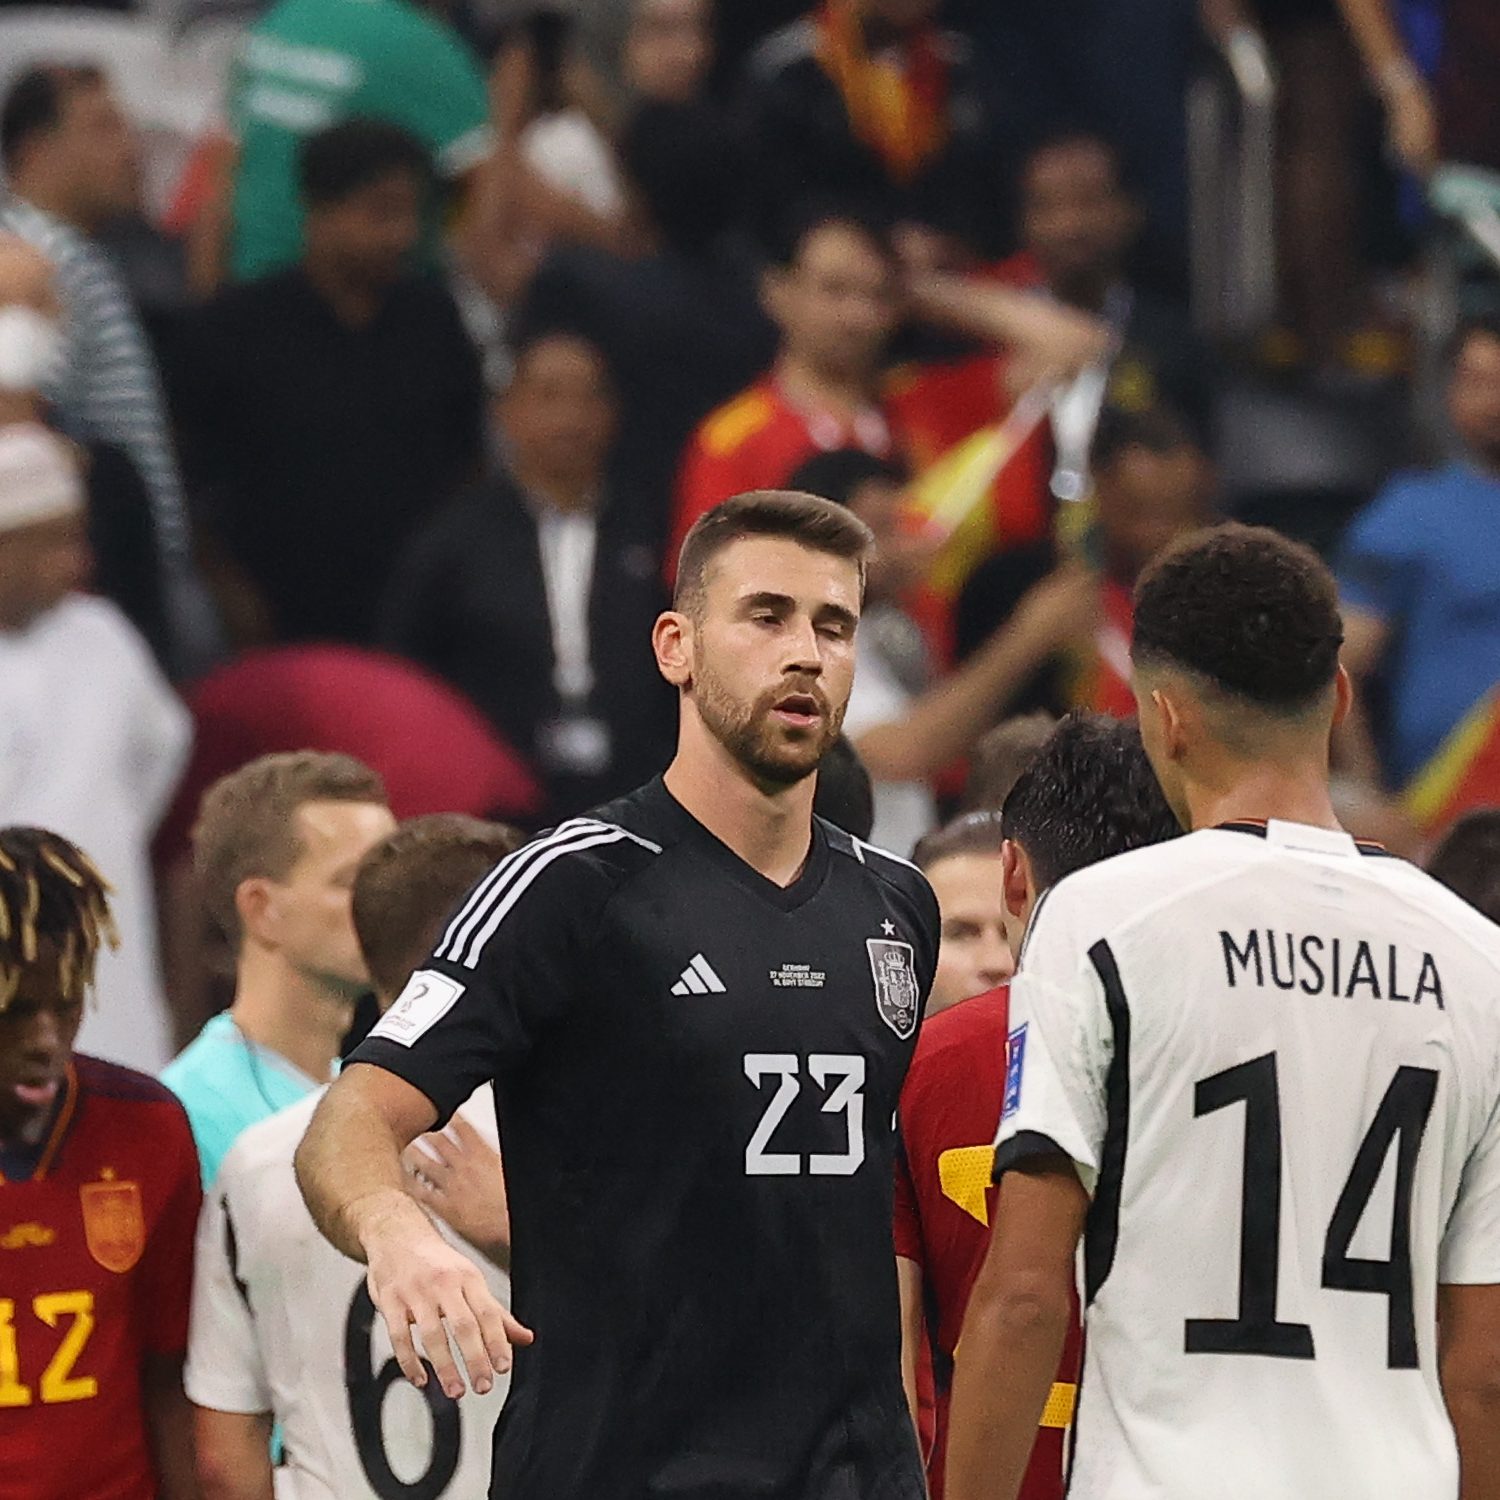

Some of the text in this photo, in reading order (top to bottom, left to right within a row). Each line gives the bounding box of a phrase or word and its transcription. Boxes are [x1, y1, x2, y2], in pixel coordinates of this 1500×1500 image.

[1218, 928, 1446, 1011] MUSIALA
[743, 1053, 866, 1176] 23
[1184, 1050, 1440, 1370] 14
